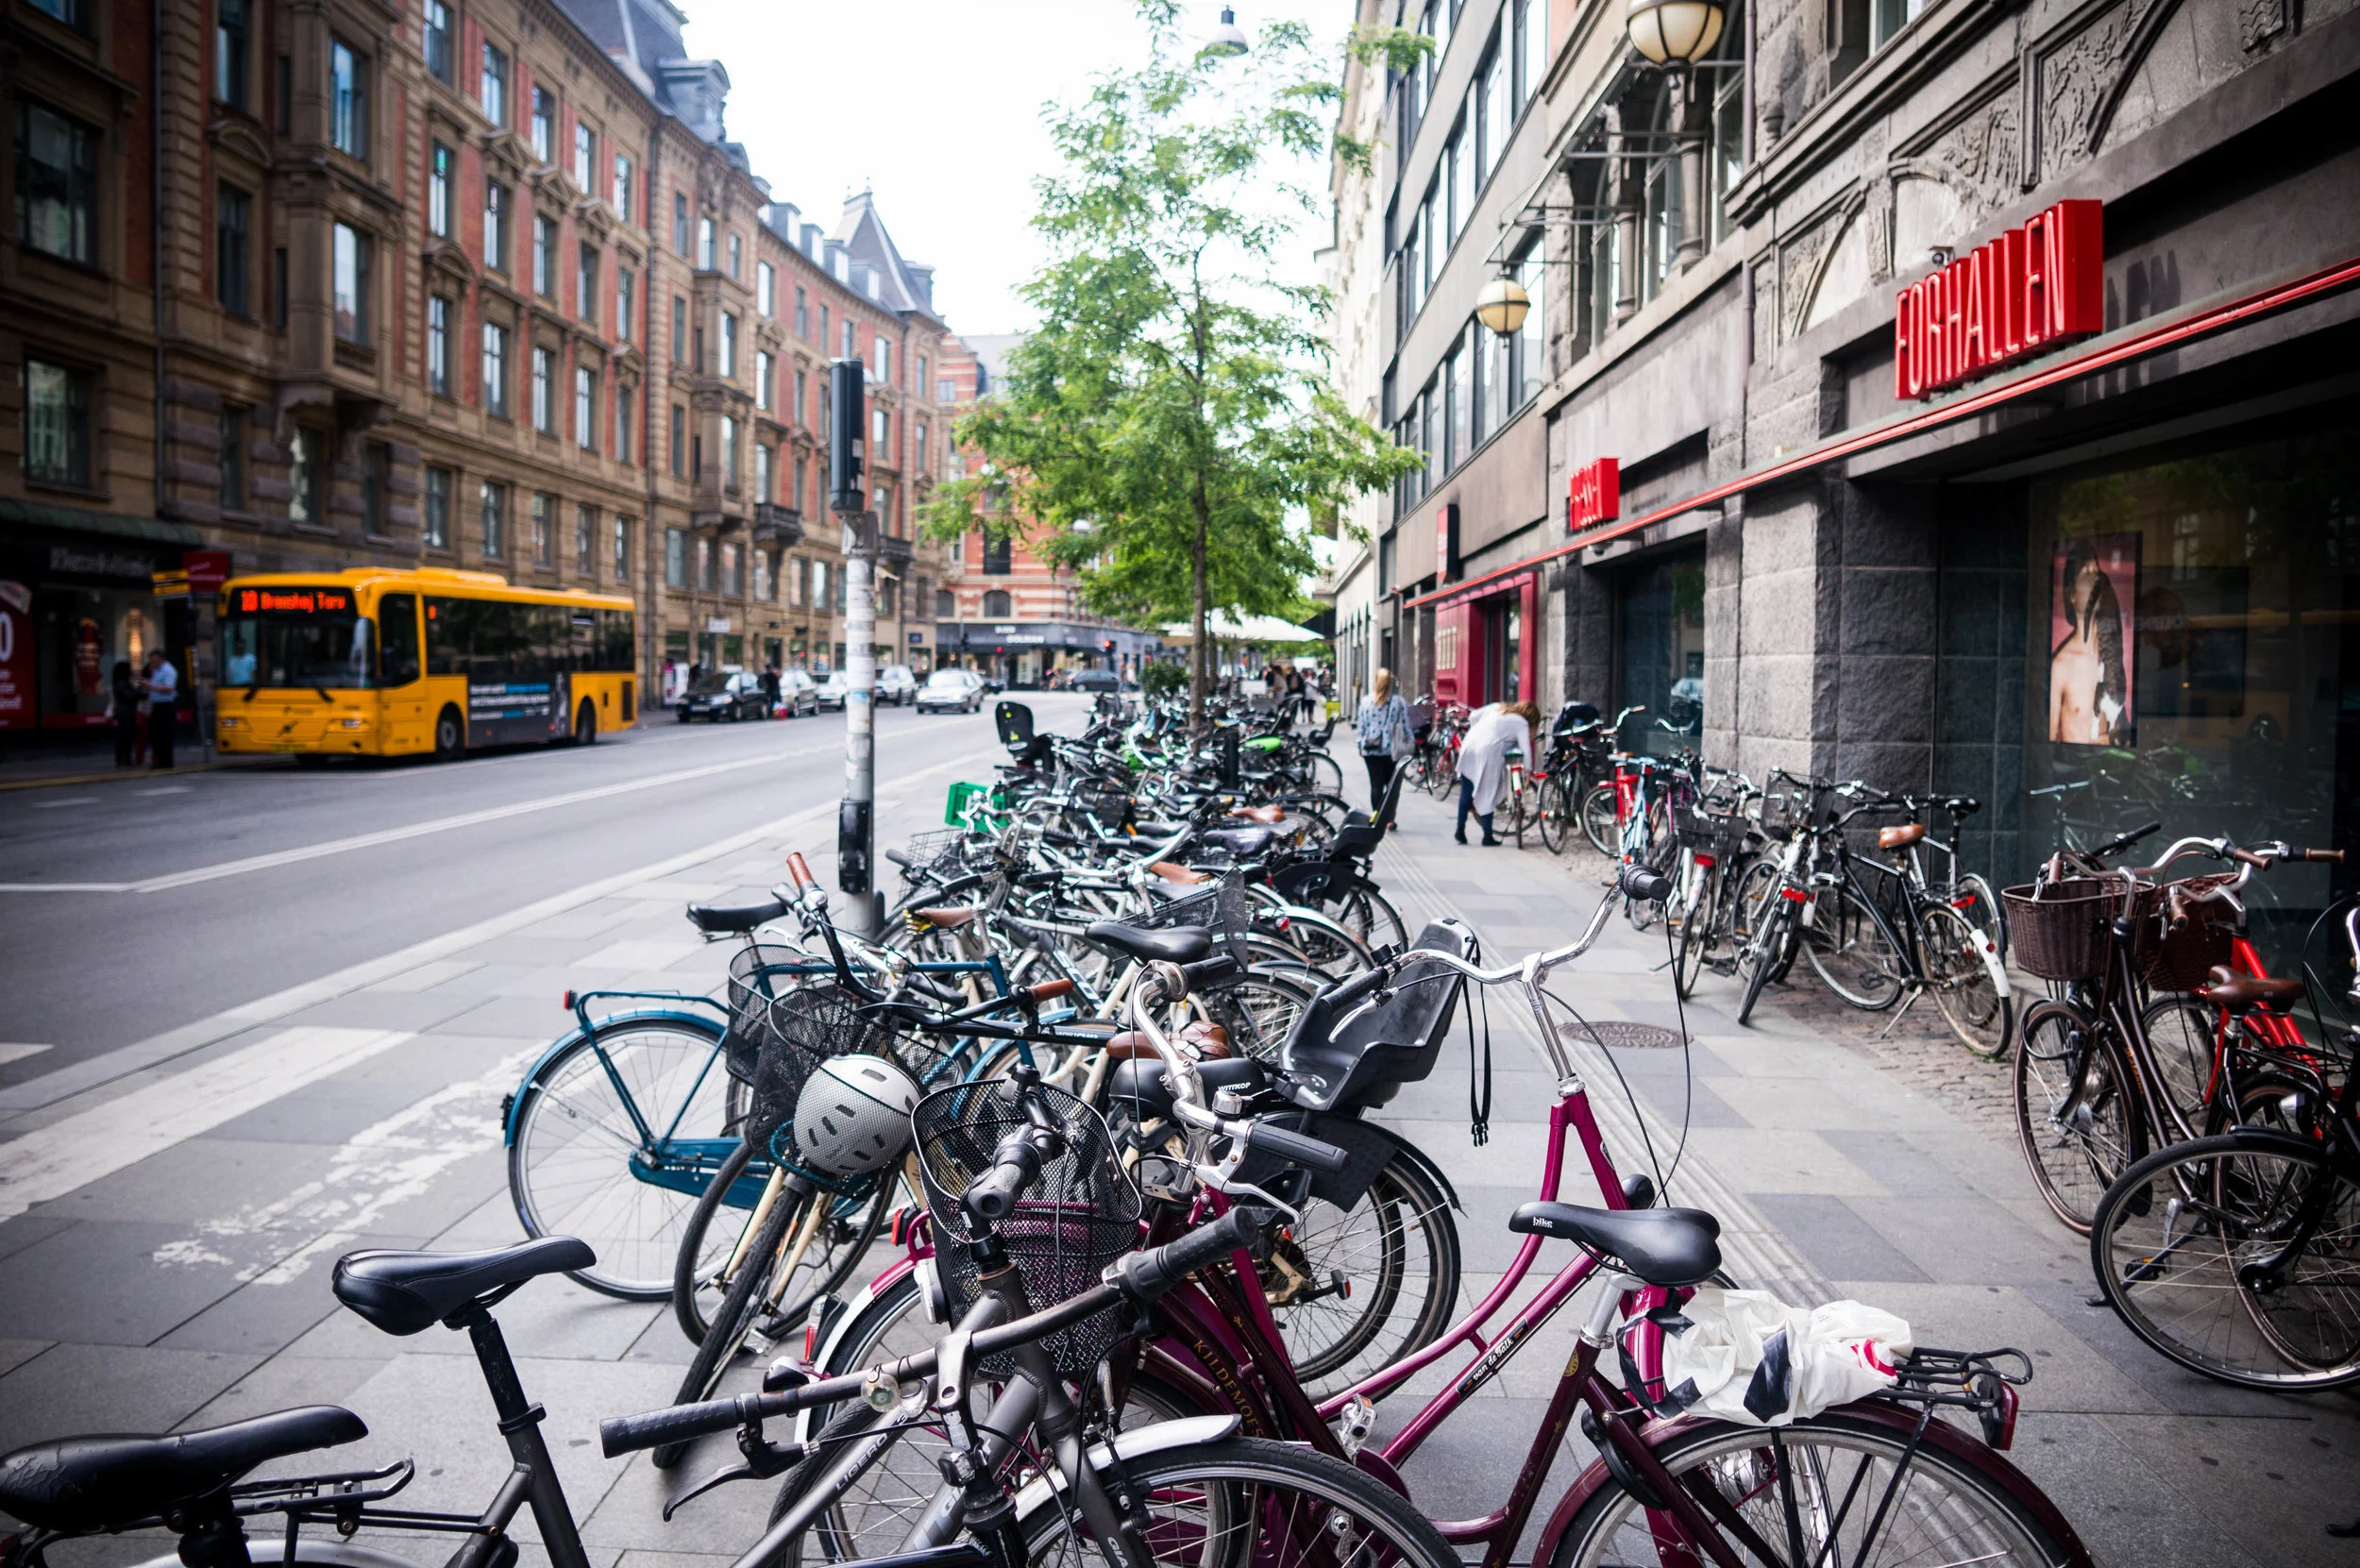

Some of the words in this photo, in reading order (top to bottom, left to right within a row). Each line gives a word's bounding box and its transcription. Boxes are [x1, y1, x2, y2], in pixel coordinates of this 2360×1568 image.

[1895, 202, 2065, 399] FORHALLEN
[1533, 1216, 1553, 1226] bike
[1193, 1339, 1264, 1437] KILDEMOES
[1473, 1364, 1489, 1380] van
[1488, 1354, 1498, 1366] de
[834, 1432, 888, 1492] LIGERO
